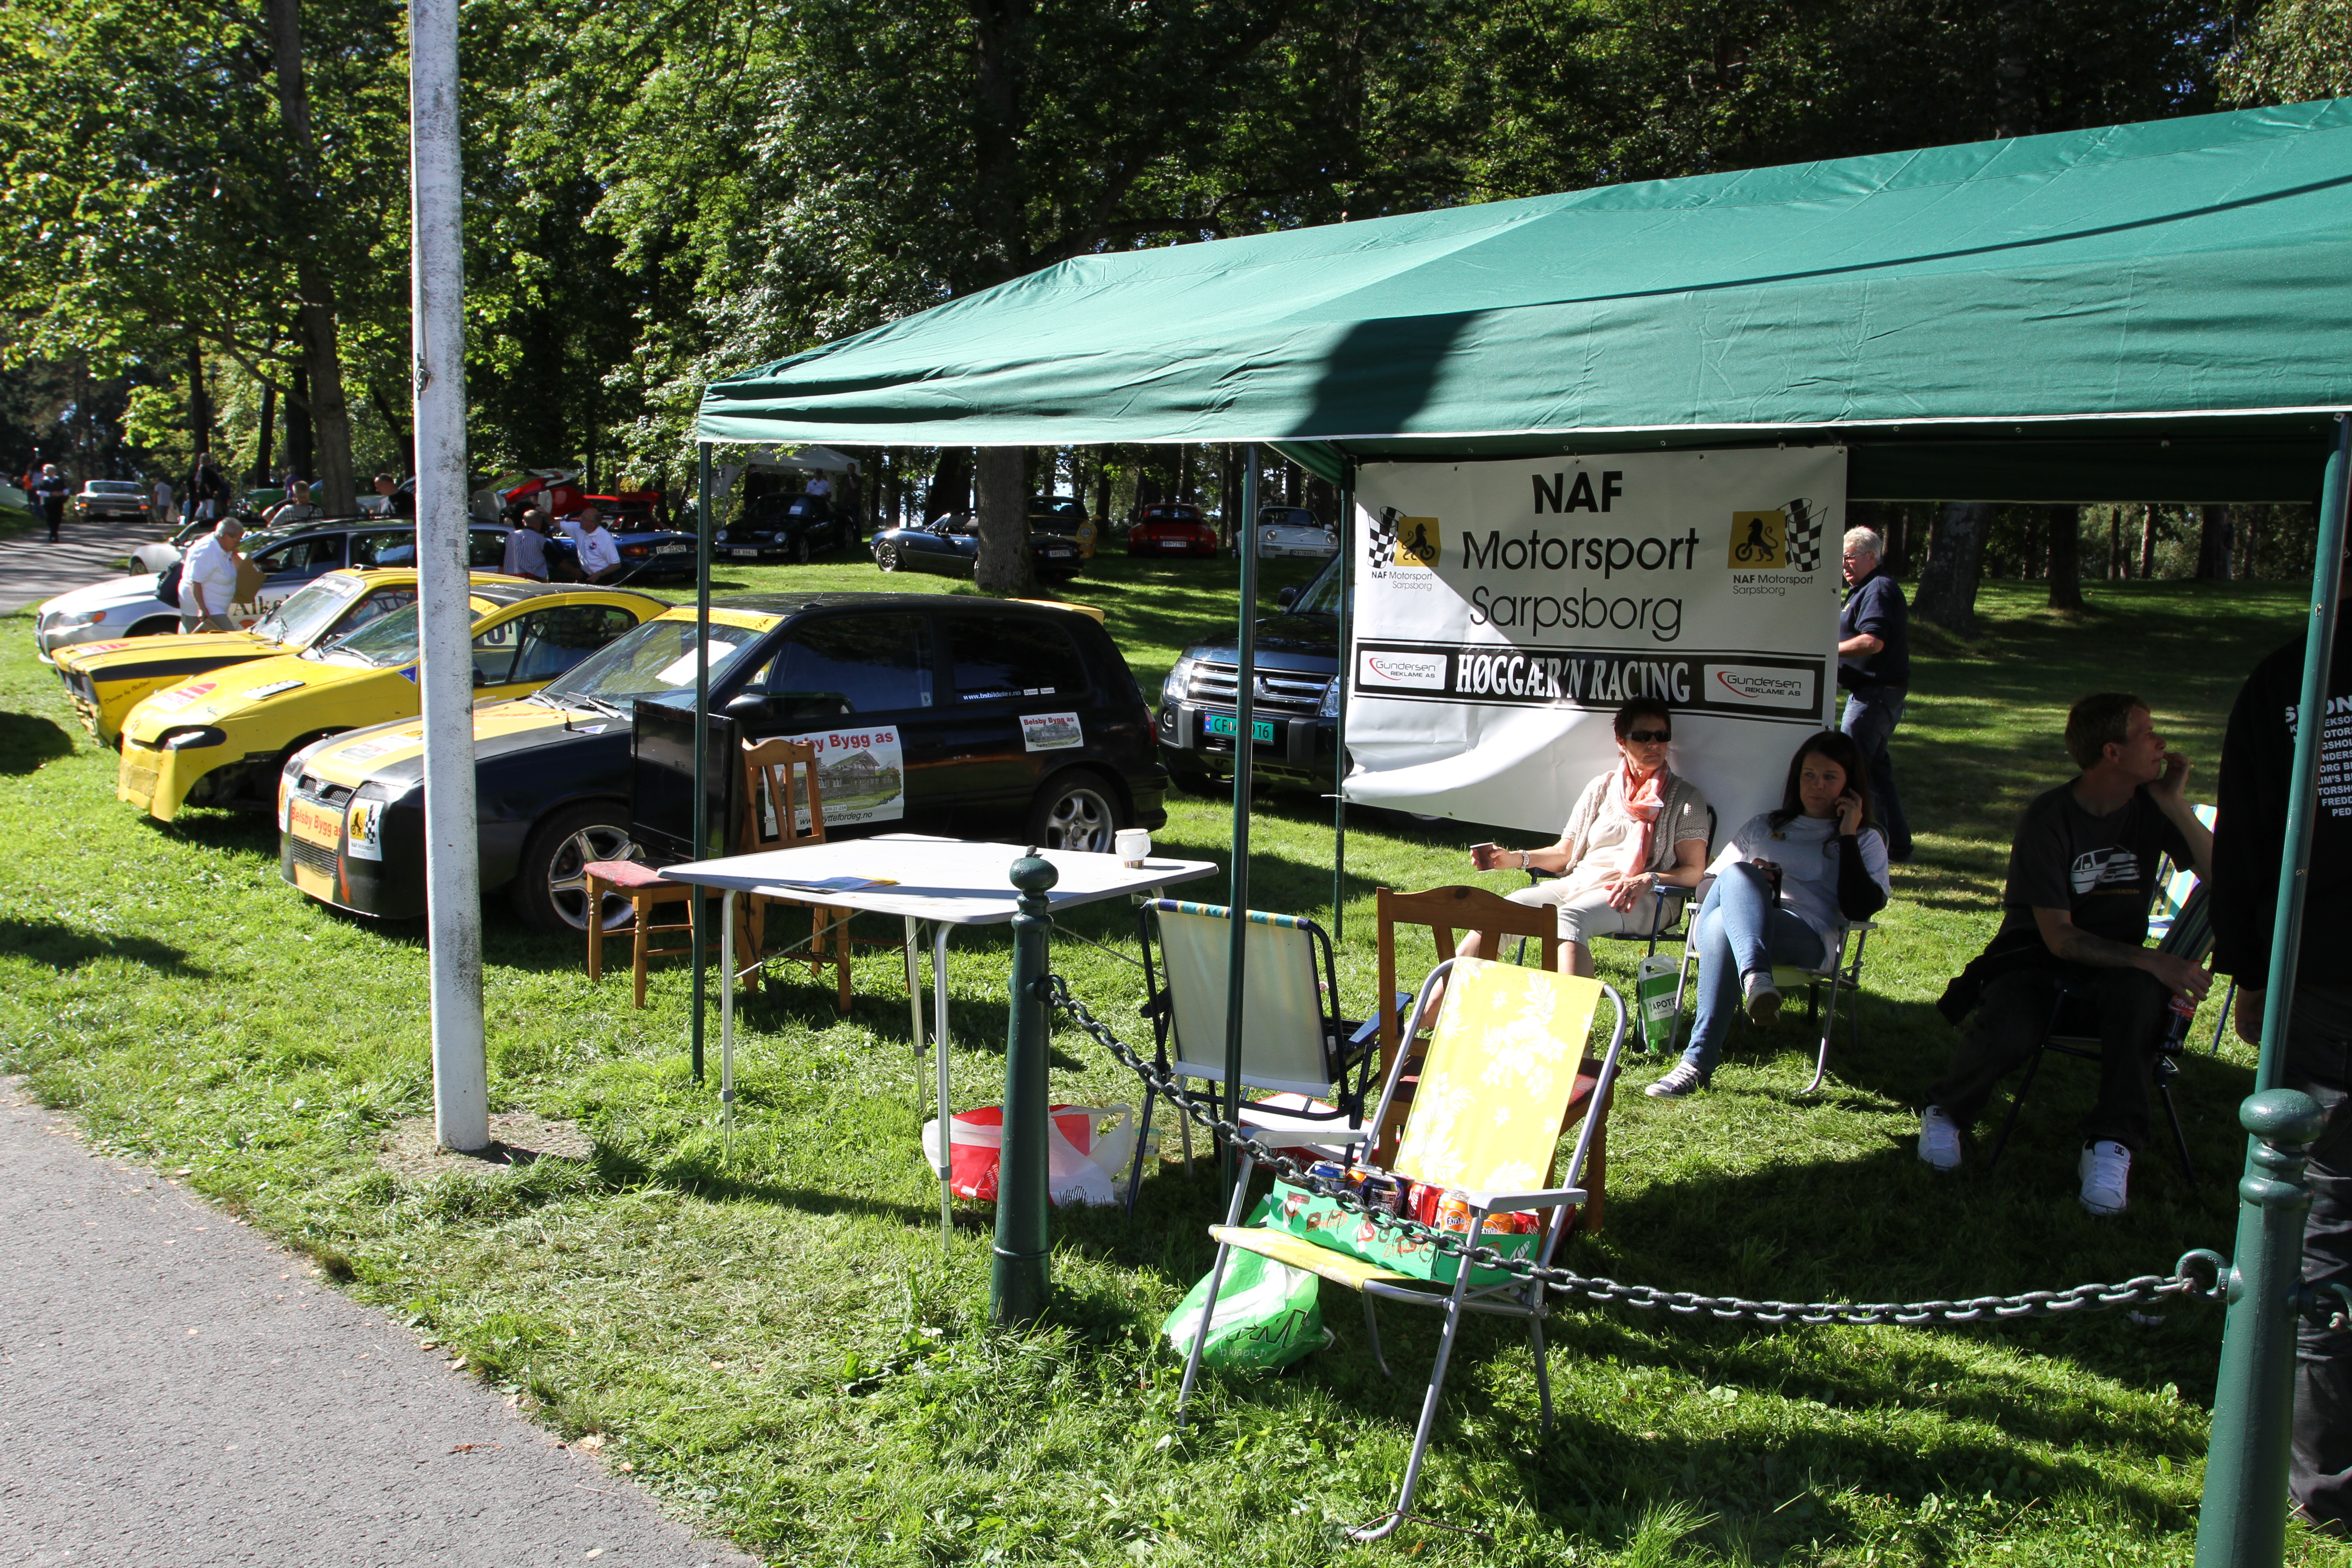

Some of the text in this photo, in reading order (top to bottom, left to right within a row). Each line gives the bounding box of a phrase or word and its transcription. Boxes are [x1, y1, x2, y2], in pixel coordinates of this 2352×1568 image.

[1532, 471, 1622, 514] NAF
[1462, 528, 1700, 579] Motorsport
[1372, 571, 1432, 581] NAF Motorsport
[1733, 574, 1813, 586] NAF Motorsport
[1392, 581, 1432, 592] Sarpsborg
[1733, 584, 1785, 596] Sarpsborg
[1470, 586, 1682, 642] Sarpsborg
[1376, 661, 1436, 672] Gundersen
[1589, 660, 1690, 703] RACING
[1727, 674, 1801, 689] Gundersen
[1745, 687, 1785, 695] REKLAME
[1215, 718, 1228, 732] CF
[828, 734, 871, 750] Bygg
[875, 732, 894, 743] as
[291, 807, 343, 838] Belsby Bygg as
[1653, 996, 1676, 1010] APOTE
[1446, 1216, 1465, 1226] Fanta
